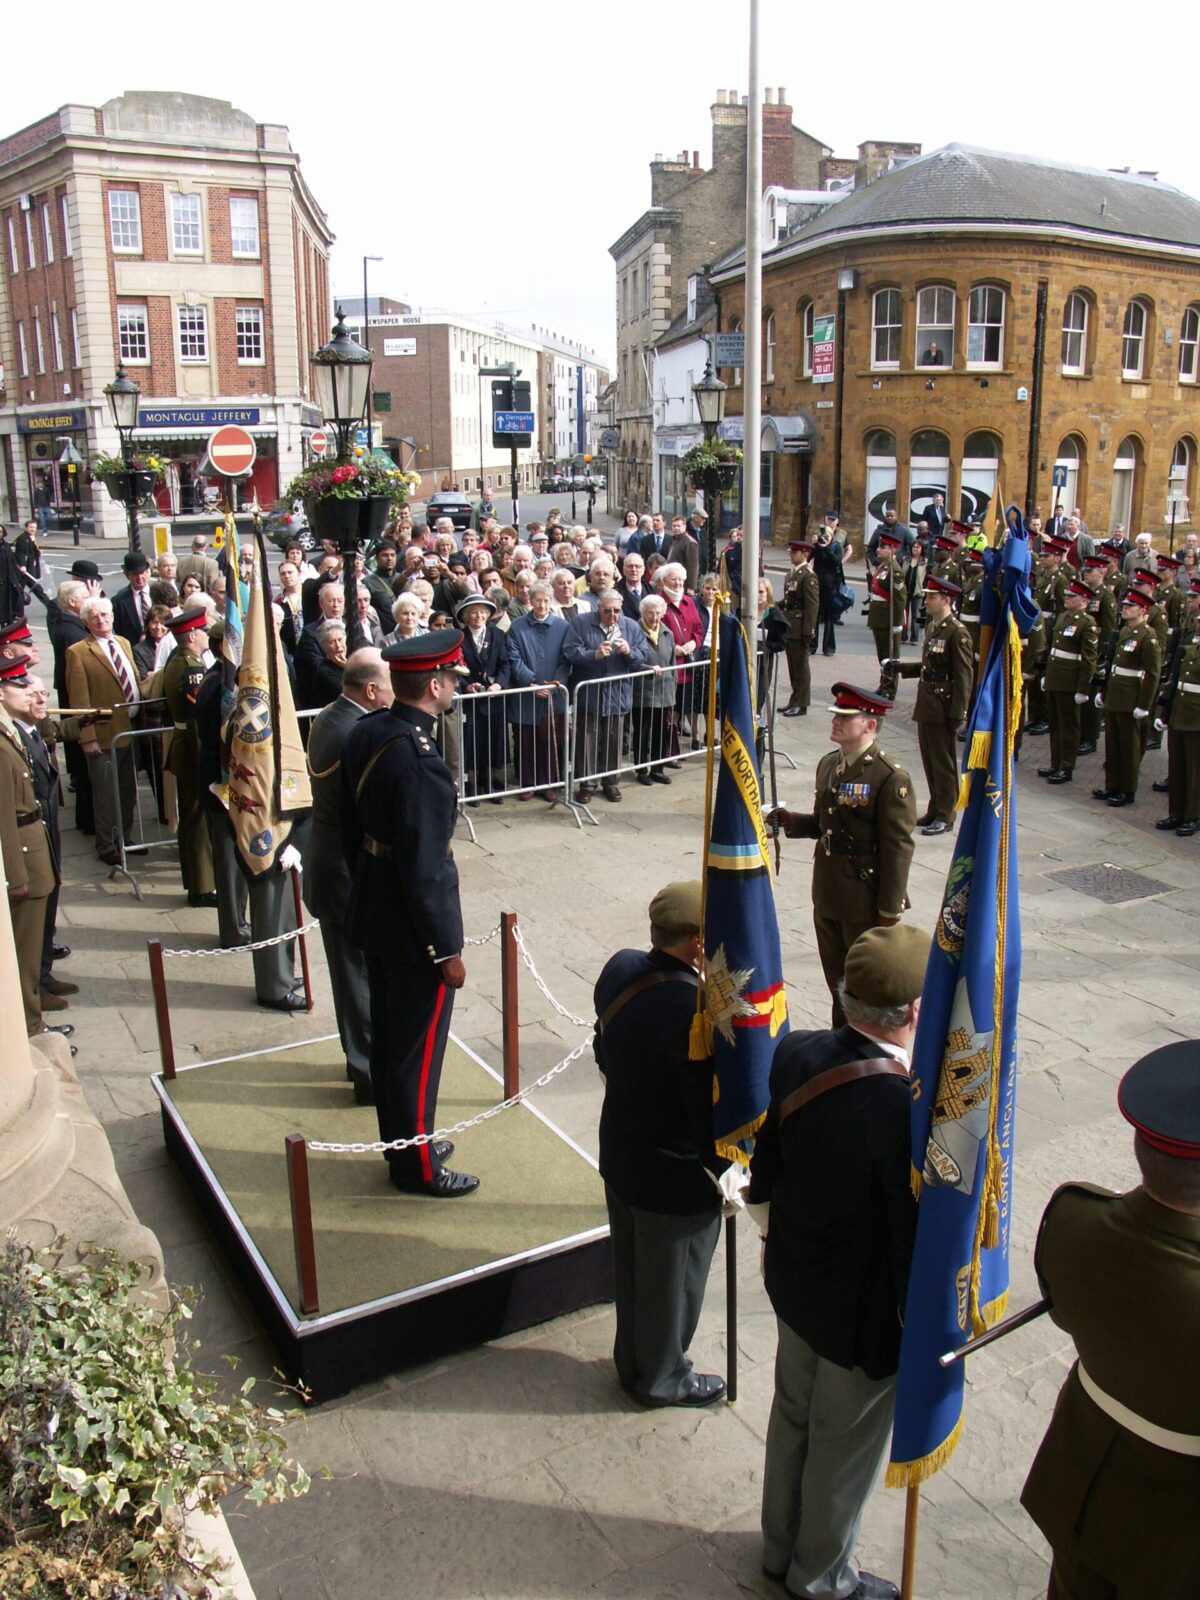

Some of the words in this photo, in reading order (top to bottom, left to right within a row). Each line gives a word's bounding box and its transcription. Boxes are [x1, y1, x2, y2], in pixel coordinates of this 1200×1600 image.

[366, 317, 399, 326] EWSPAPER
[814, 343, 833, 353] OFFICES
[816, 365, 822, 373] TO
[823, 364, 831, 372] LET
[28, 417, 54, 429] MONTAGUE
[55, 416, 73, 428] JEFFERY
[146, 411, 205, 423] MONTAGUE
[211, 411, 252, 422] JEFFERY
[943, 909, 965, 936] TALAV
[1001, 1061, 1016, 1149] ANGLIAN
[1001, 1155, 1010, 1219] ROYAL
[1001, 1222, 1009, 1260] THE
